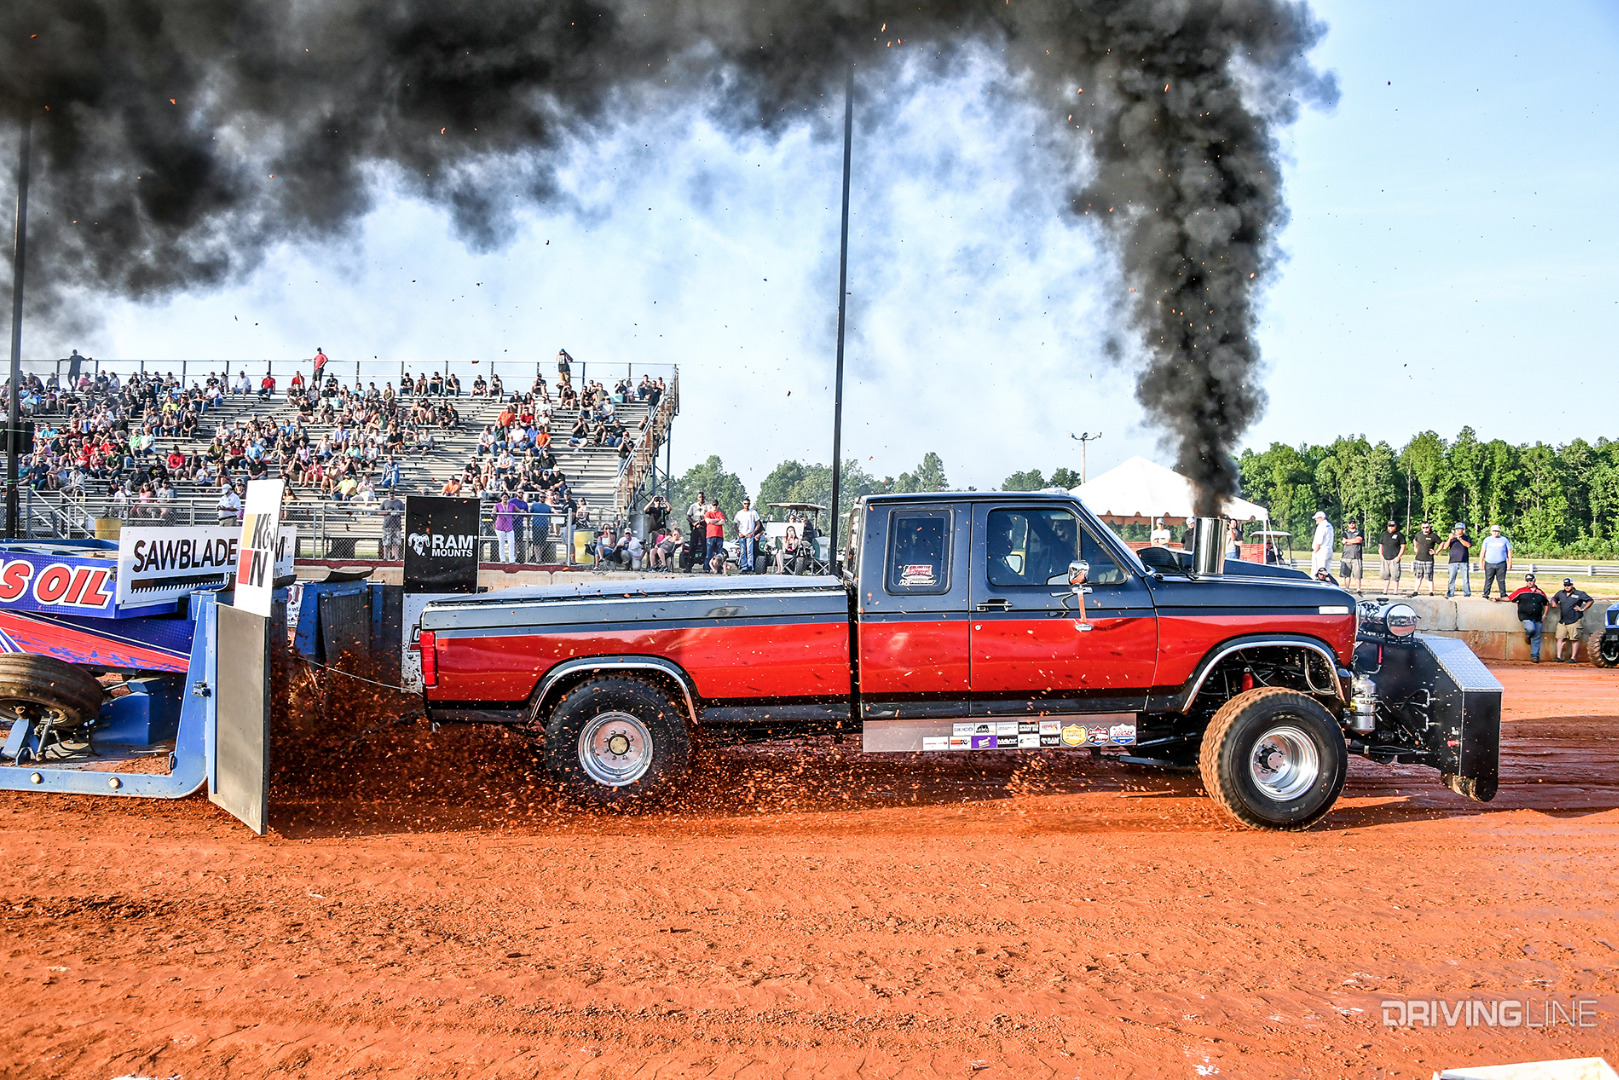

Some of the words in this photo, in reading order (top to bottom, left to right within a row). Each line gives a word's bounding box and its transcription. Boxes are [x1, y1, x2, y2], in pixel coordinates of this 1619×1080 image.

[431, 533, 475, 549] RAM
[431, 548, 474, 557] MOUNTS
[34, 564, 112, 608] OIL
